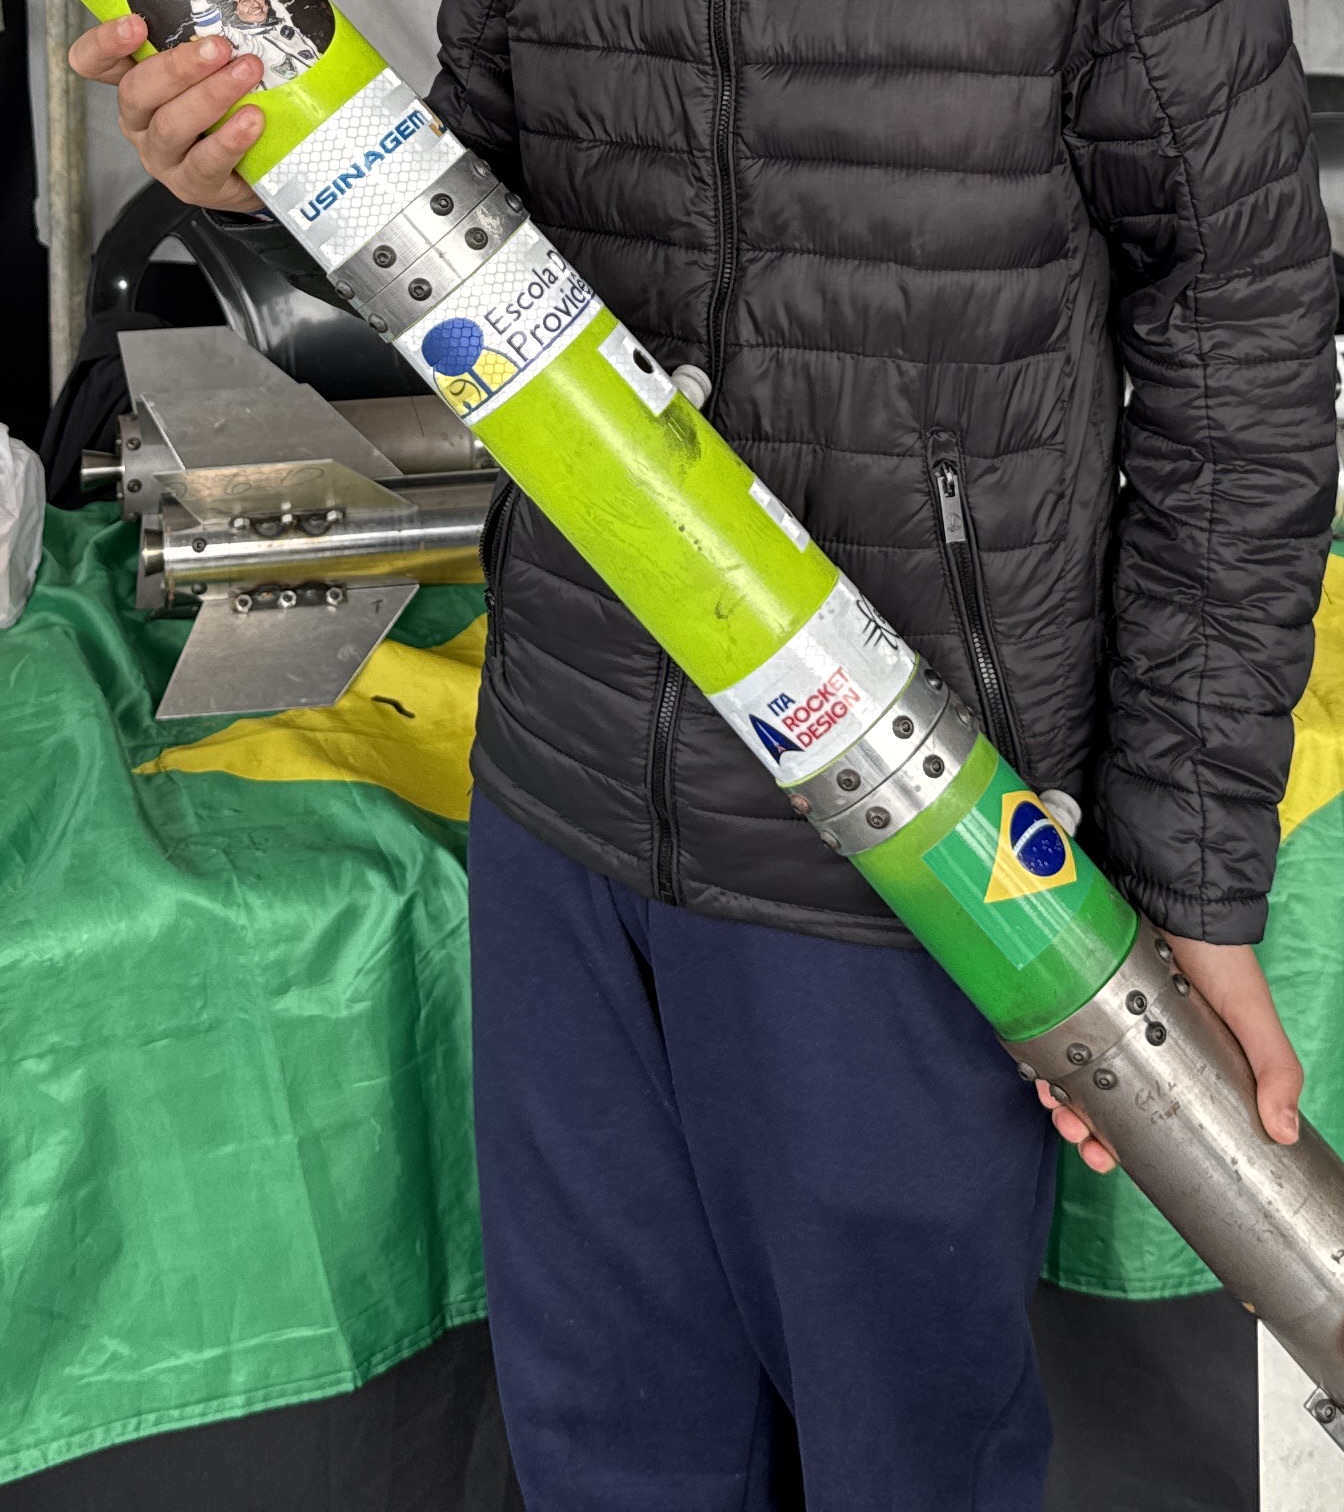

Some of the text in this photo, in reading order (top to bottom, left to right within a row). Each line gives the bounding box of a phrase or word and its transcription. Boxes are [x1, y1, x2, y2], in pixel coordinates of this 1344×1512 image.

[299, 108, 430, 223] USINAGEM
[483, 267, 559, 336] Escola
[767, 692, 796, 717] ITA
[781, 666, 850, 733] ROCKET
[796, 686, 862, 749] DESIGN
